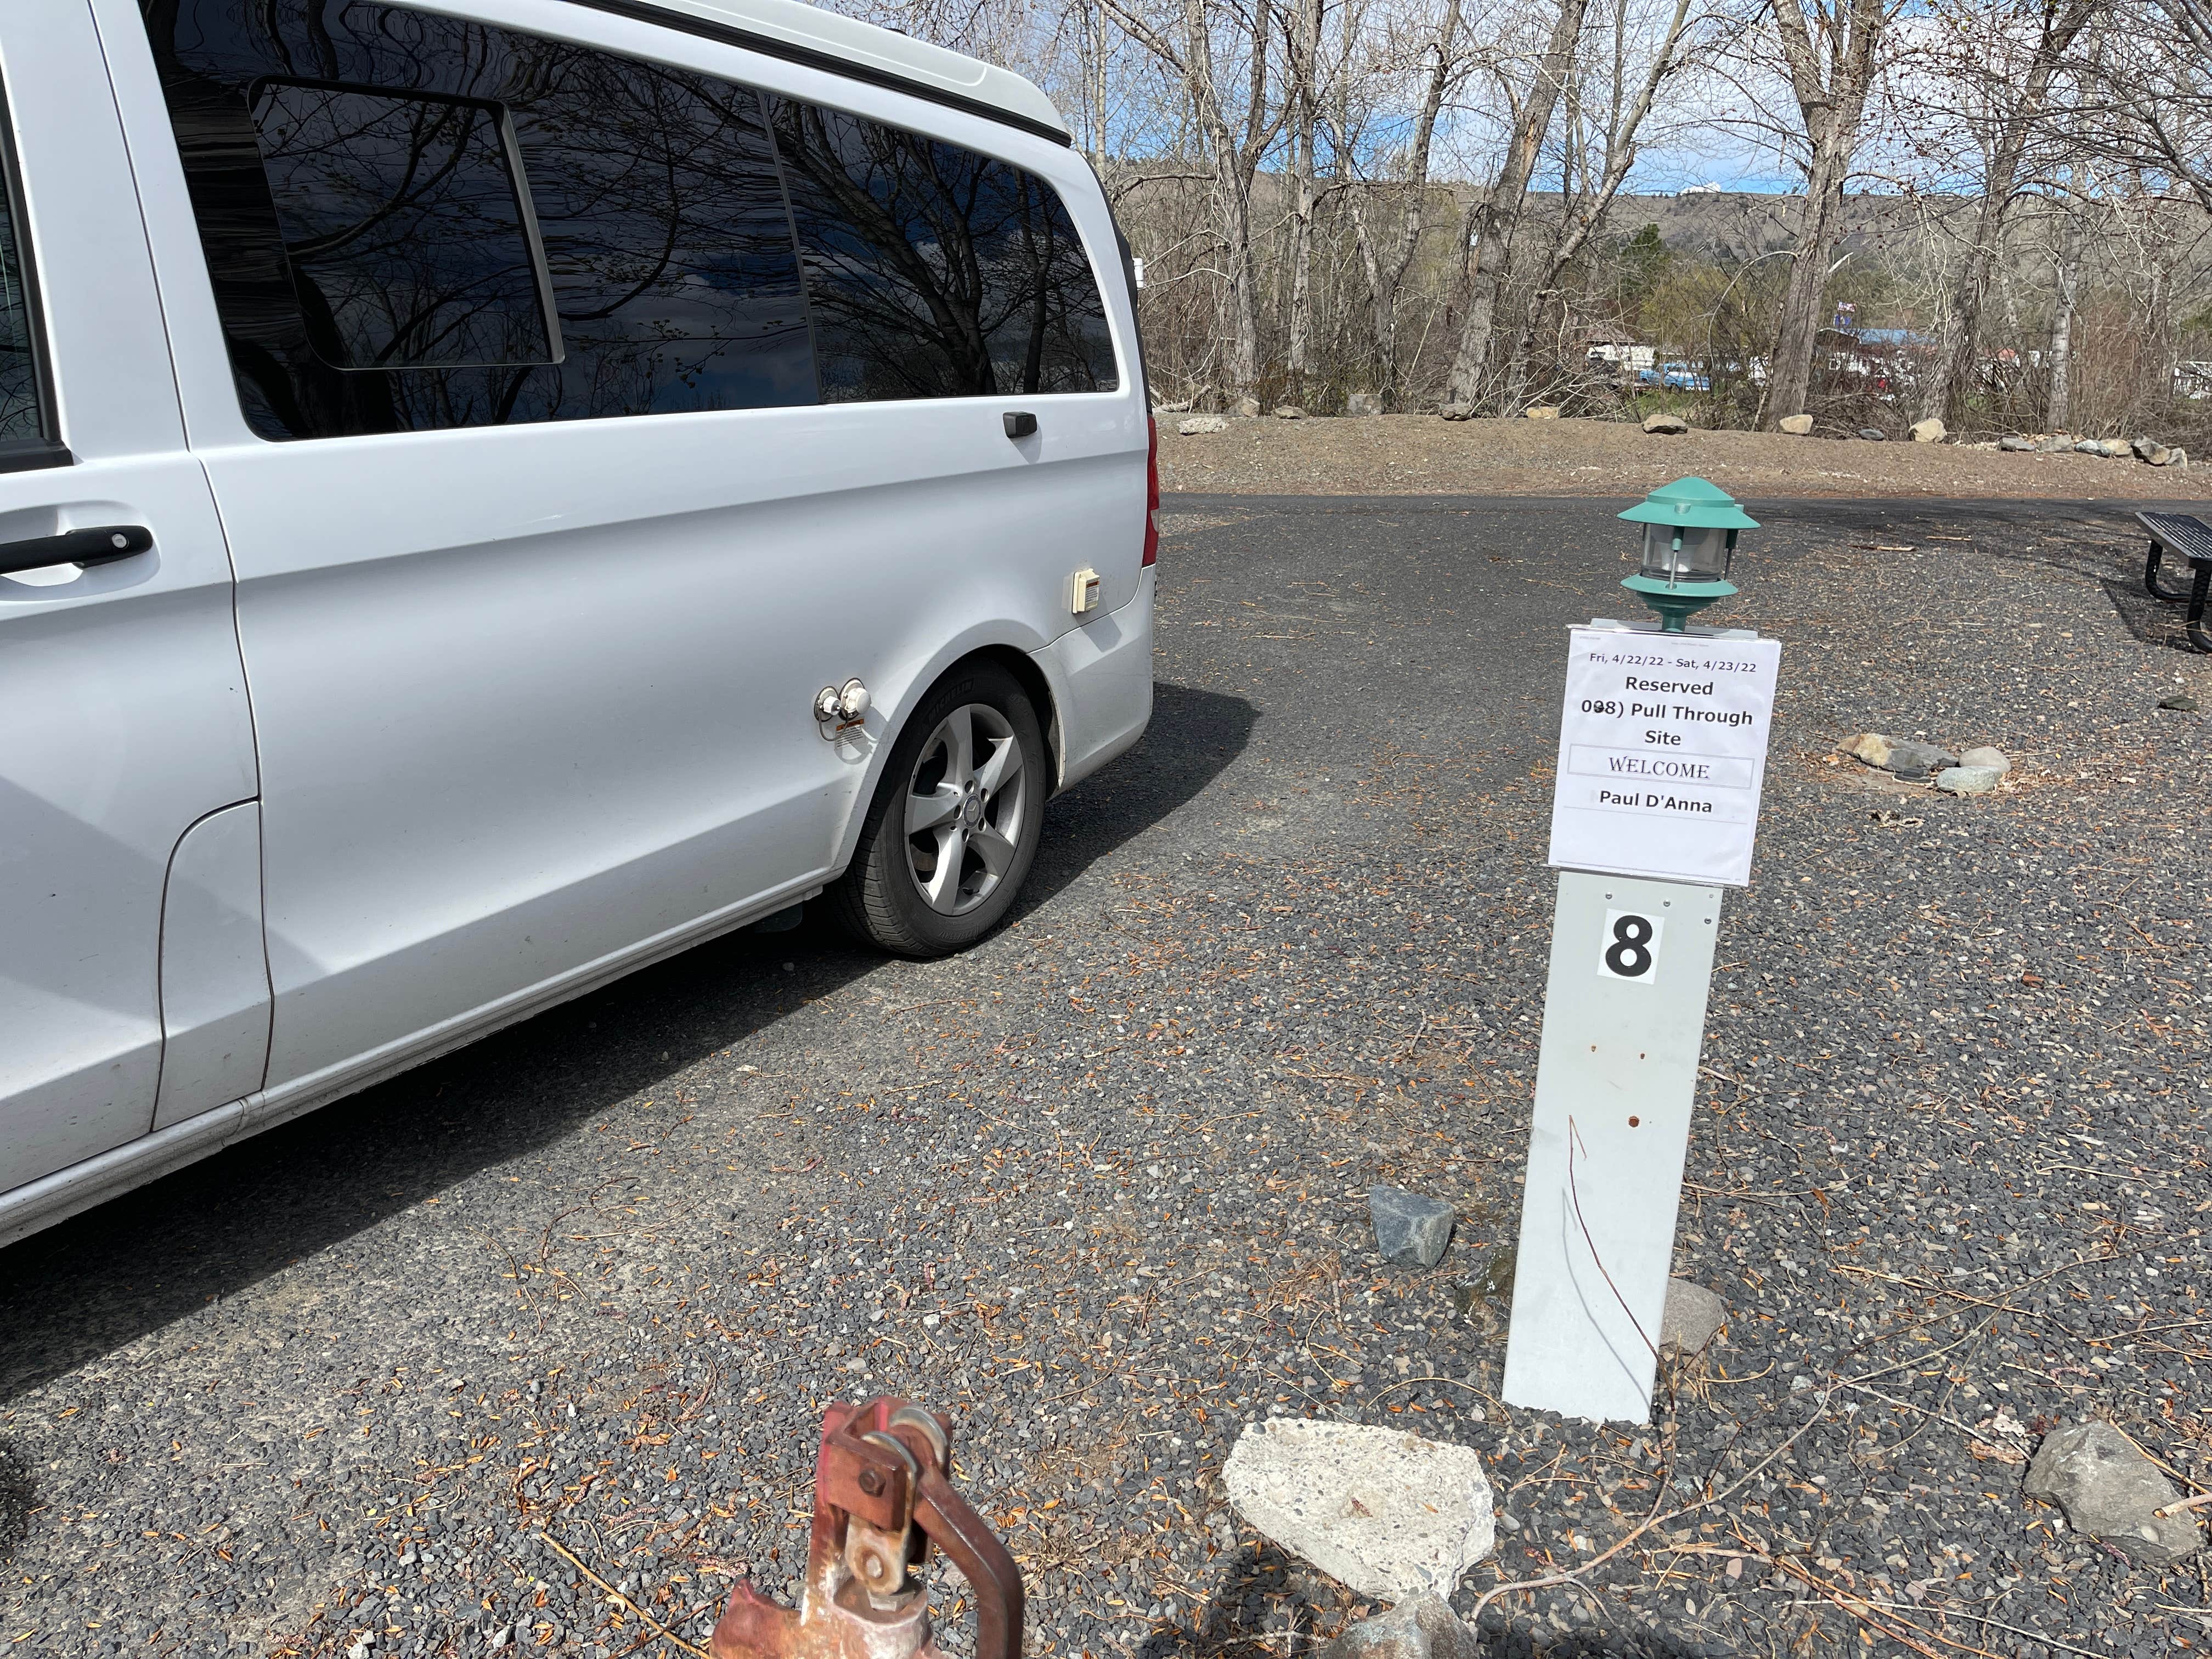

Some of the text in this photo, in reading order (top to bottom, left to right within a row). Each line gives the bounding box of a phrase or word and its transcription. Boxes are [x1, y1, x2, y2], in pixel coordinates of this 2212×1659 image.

[1590, 653, 1608, 664] Fri,
[1612, 654, 1663, 667] 4/22/22
[1676, 658, 1699, 670] Sat,
[1703, 661, 1756, 673] 4/23/22
[1626, 676, 1714, 696] Reserved
[1631, 703, 1666, 719] Pull
[1672, 706, 1753, 727] Through
[1645, 730, 1681, 746] Site
[1608, 755, 1711, 780] WELCOME
[1600, 790, 1713, 813] Paul D'Anna
[1606, 915, 1653, 977] 8
